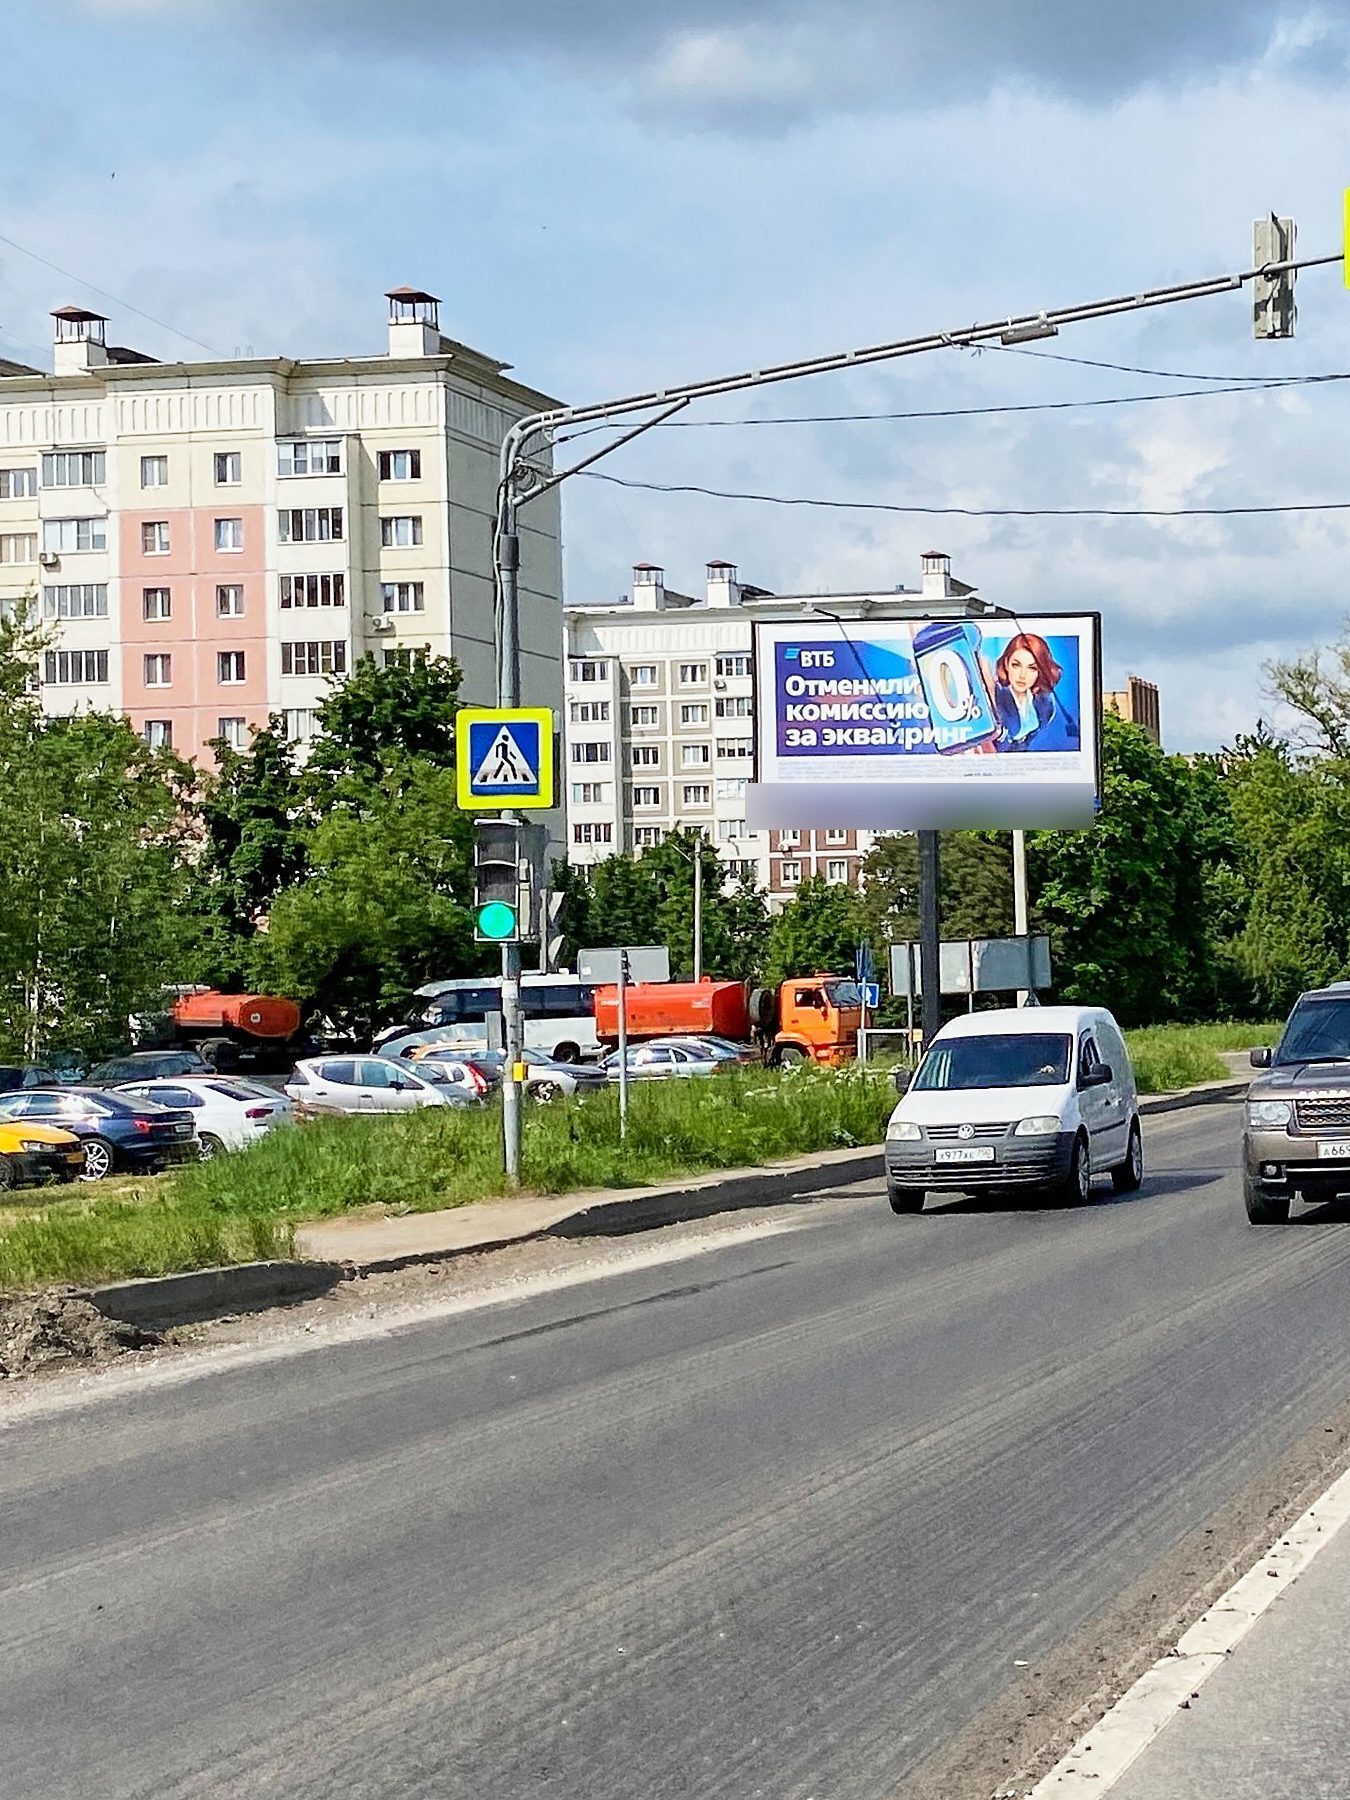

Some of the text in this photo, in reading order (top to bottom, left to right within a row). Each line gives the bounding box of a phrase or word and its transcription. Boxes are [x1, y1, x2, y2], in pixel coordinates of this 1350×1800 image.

[801, 650, 835, 667] ВТБ
[785, 675, 922, 696] Отменили
[786, 702, 929, 721] комиссию
[785, 720, 973, 750] за эквайринг
